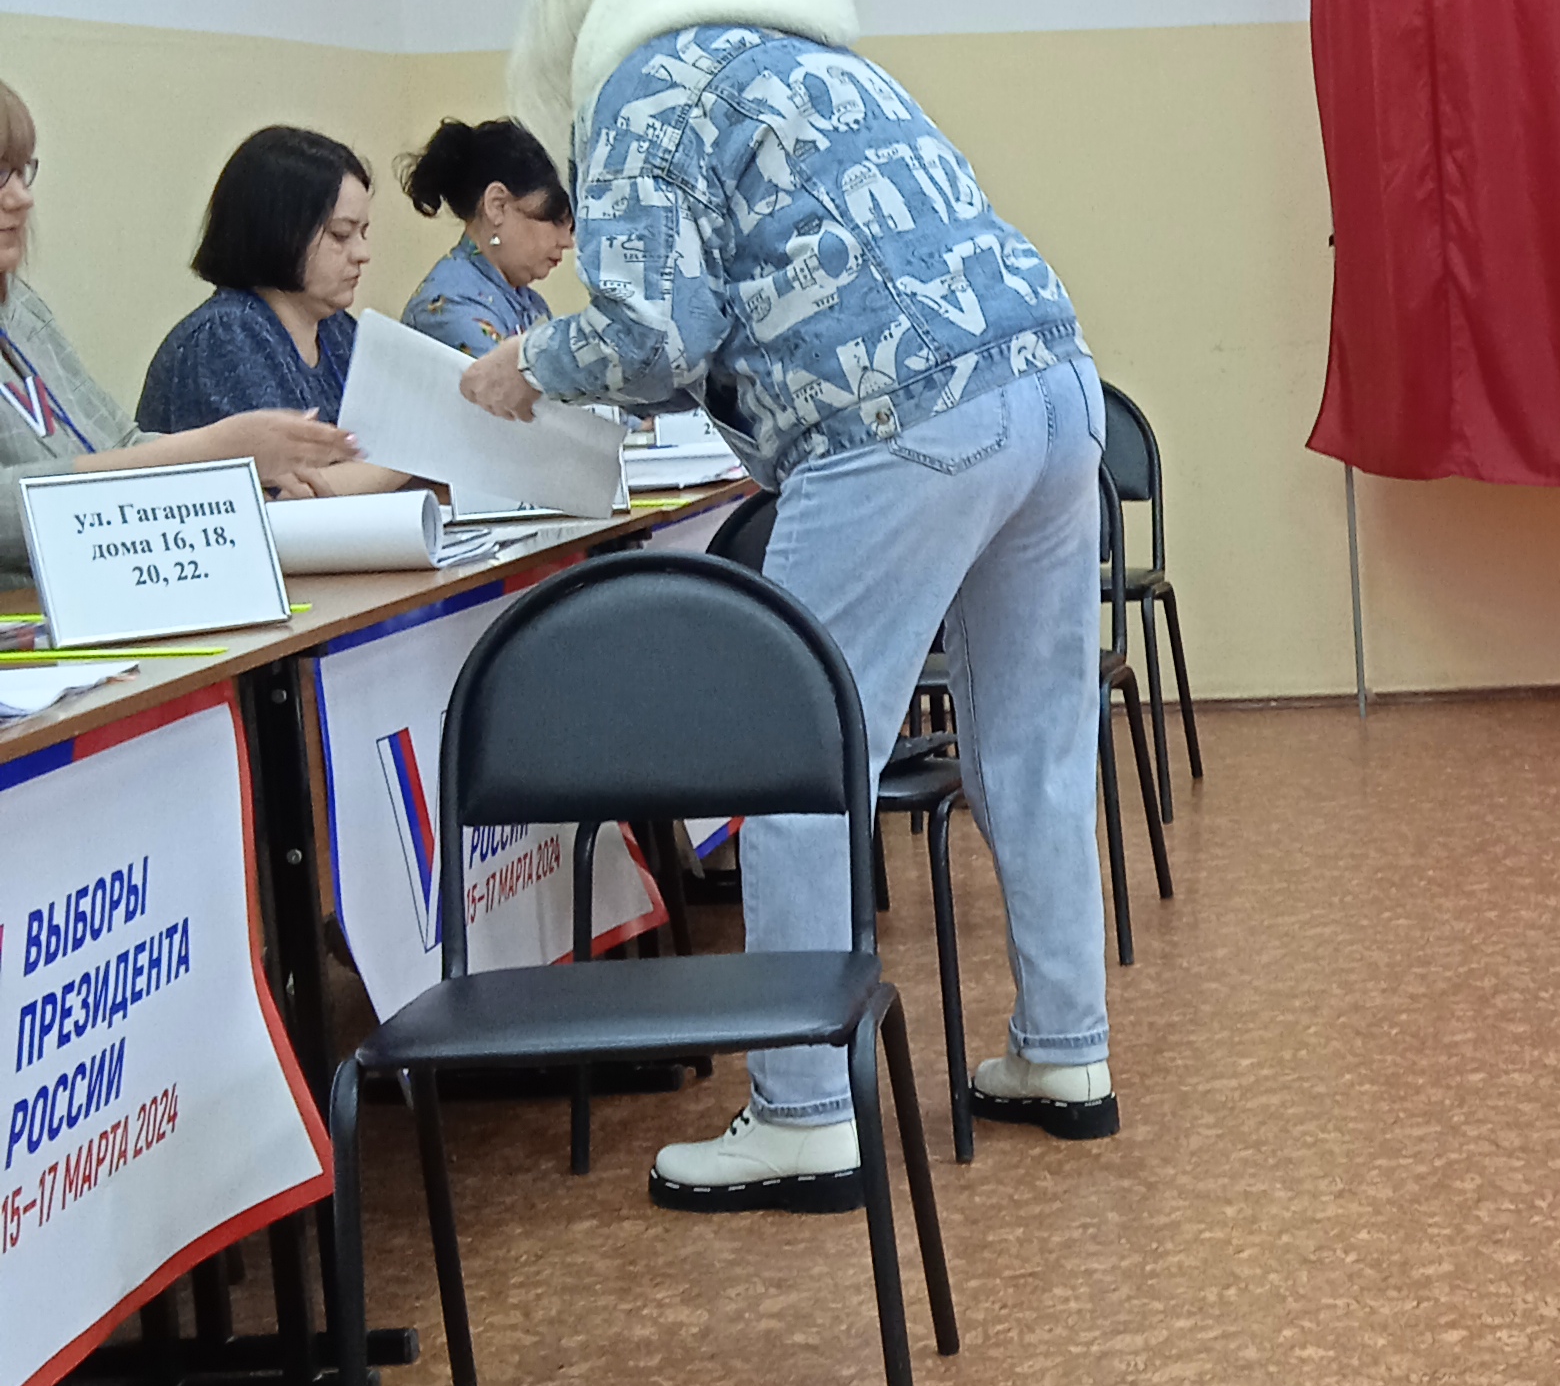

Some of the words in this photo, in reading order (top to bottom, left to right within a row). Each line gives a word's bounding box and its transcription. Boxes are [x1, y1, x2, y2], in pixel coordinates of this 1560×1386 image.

[74, 512, 112, 534] ул.
[118, 499, 236, 525] Гагарина
[92, 537, 153, 561] дома
[160, 531, 195, 553] 16,
[201, 526, 236, 549] 18,
[132, 564, 169, 587] 20,
[174, 560, 209, 582] 22.
[23, 855, 149, 977] ВЫБОРЫ
[498, 849, 533, 906] МАРТА
[536, 834, 561, 881] 2024
[16, 917, 190, 1073] ПРЕЗИДЕНТА
[4, 1036, 126, 1171] РОССИИ
[61, 1115, 129, 1210] МАРТА
[132, 1082, 178, 1159] 2024
